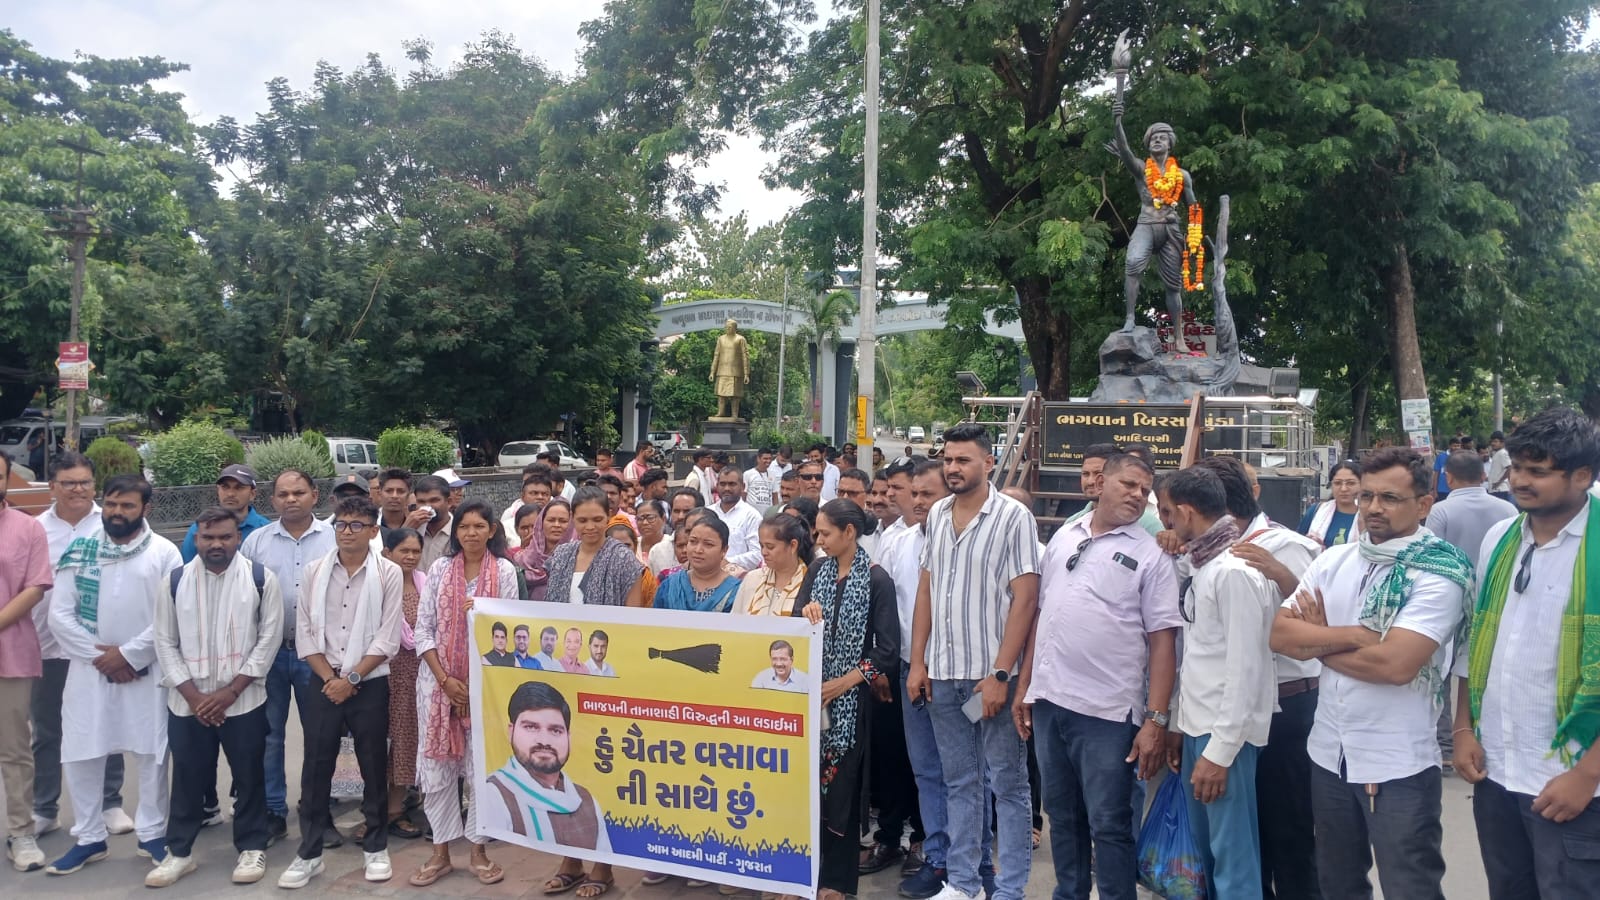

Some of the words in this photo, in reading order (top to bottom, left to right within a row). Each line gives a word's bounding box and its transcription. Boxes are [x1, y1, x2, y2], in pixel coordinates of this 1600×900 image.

[1056, 415, 1127, 426] ભગવાન
[1113, 433, 1170, 443] આદિવાસી
[583, 700, 628, 715] ભાજપની
[630, 705, 680, 720] તાનાશાહી
[682, 707, 730, 725] વિરુદ્ધની
[733, 714, 750, 726] આ
[753, 716, 798, 732] લડાઈમાં
[594, 727, 614, 774] હું
[621, 722, 686, 765] ચૈતર
[695, 741, 789, 773] વસાવા
[616, 769, 647, 805] ની
[655, 774, 718, 812] સાથે
[726, 781, 764, 829] છું.
[646, 842, 668, 856] આમ
[671, 845, 703, 861] આદમી
[704, 852, 727, 866] પાર્ટી
[735, 860, 772, 874] ગુજરાત
